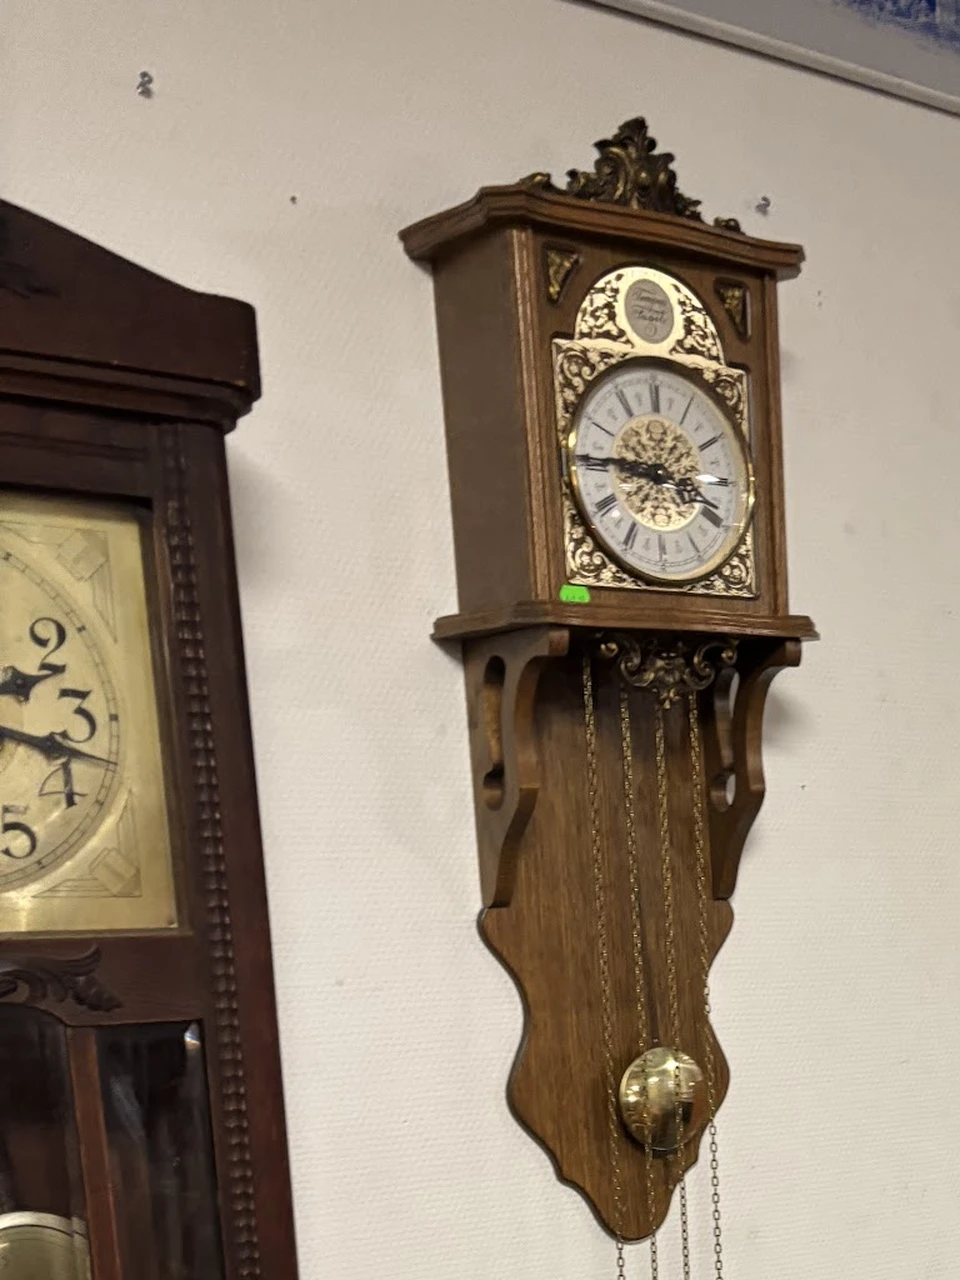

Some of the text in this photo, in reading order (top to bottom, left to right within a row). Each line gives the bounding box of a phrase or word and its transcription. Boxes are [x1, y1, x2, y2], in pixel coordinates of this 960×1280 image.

[29, 617, 67, 674] 2
[52, 688, 97, 743] 3
[38, 757, 88, 809] 4
[1, 804, 37, 860] 5
